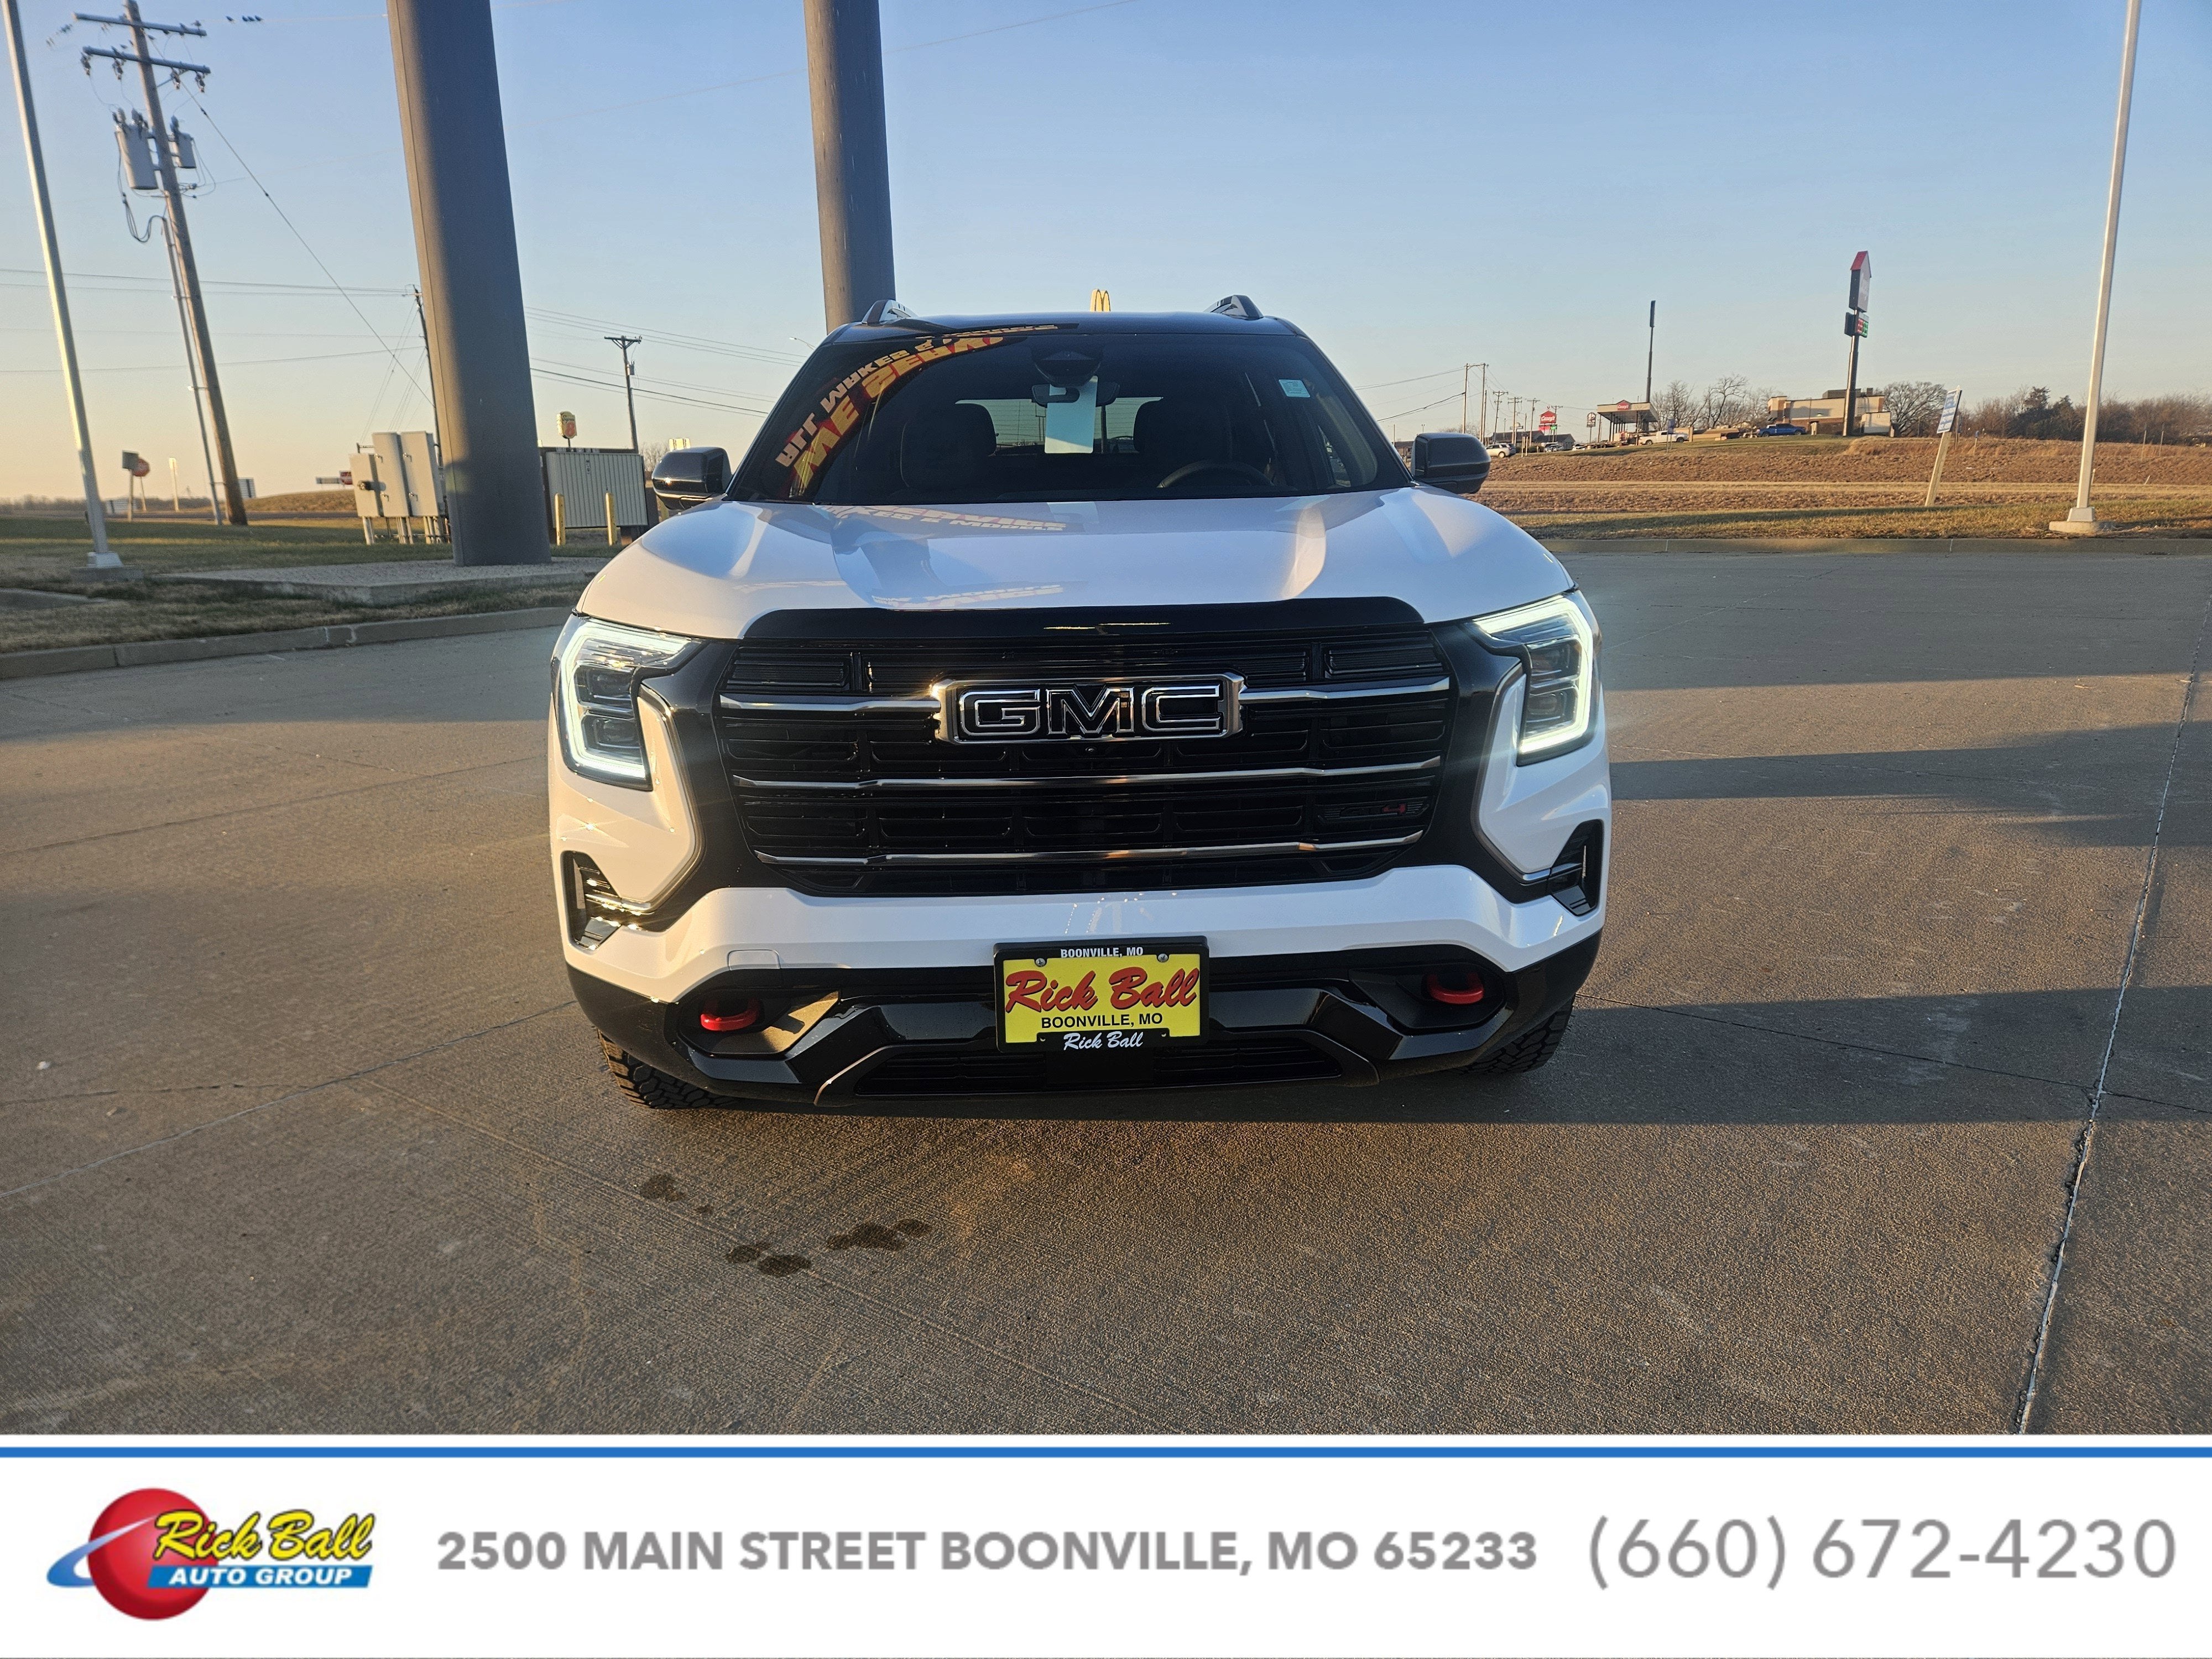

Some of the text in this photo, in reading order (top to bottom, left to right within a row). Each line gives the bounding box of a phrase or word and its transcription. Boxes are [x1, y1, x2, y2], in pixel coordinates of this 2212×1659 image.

[959, 684, 1220, 735] GMC
[1060, 947, 1144, 958] BOONVILLE, MO
[1005, 967, 1199, 1013] Rick Ball
[1041, 1013, 1163, 1029] BOONVILLE, MO
[1063, 1031, 1143, 1051] Rick Ball
